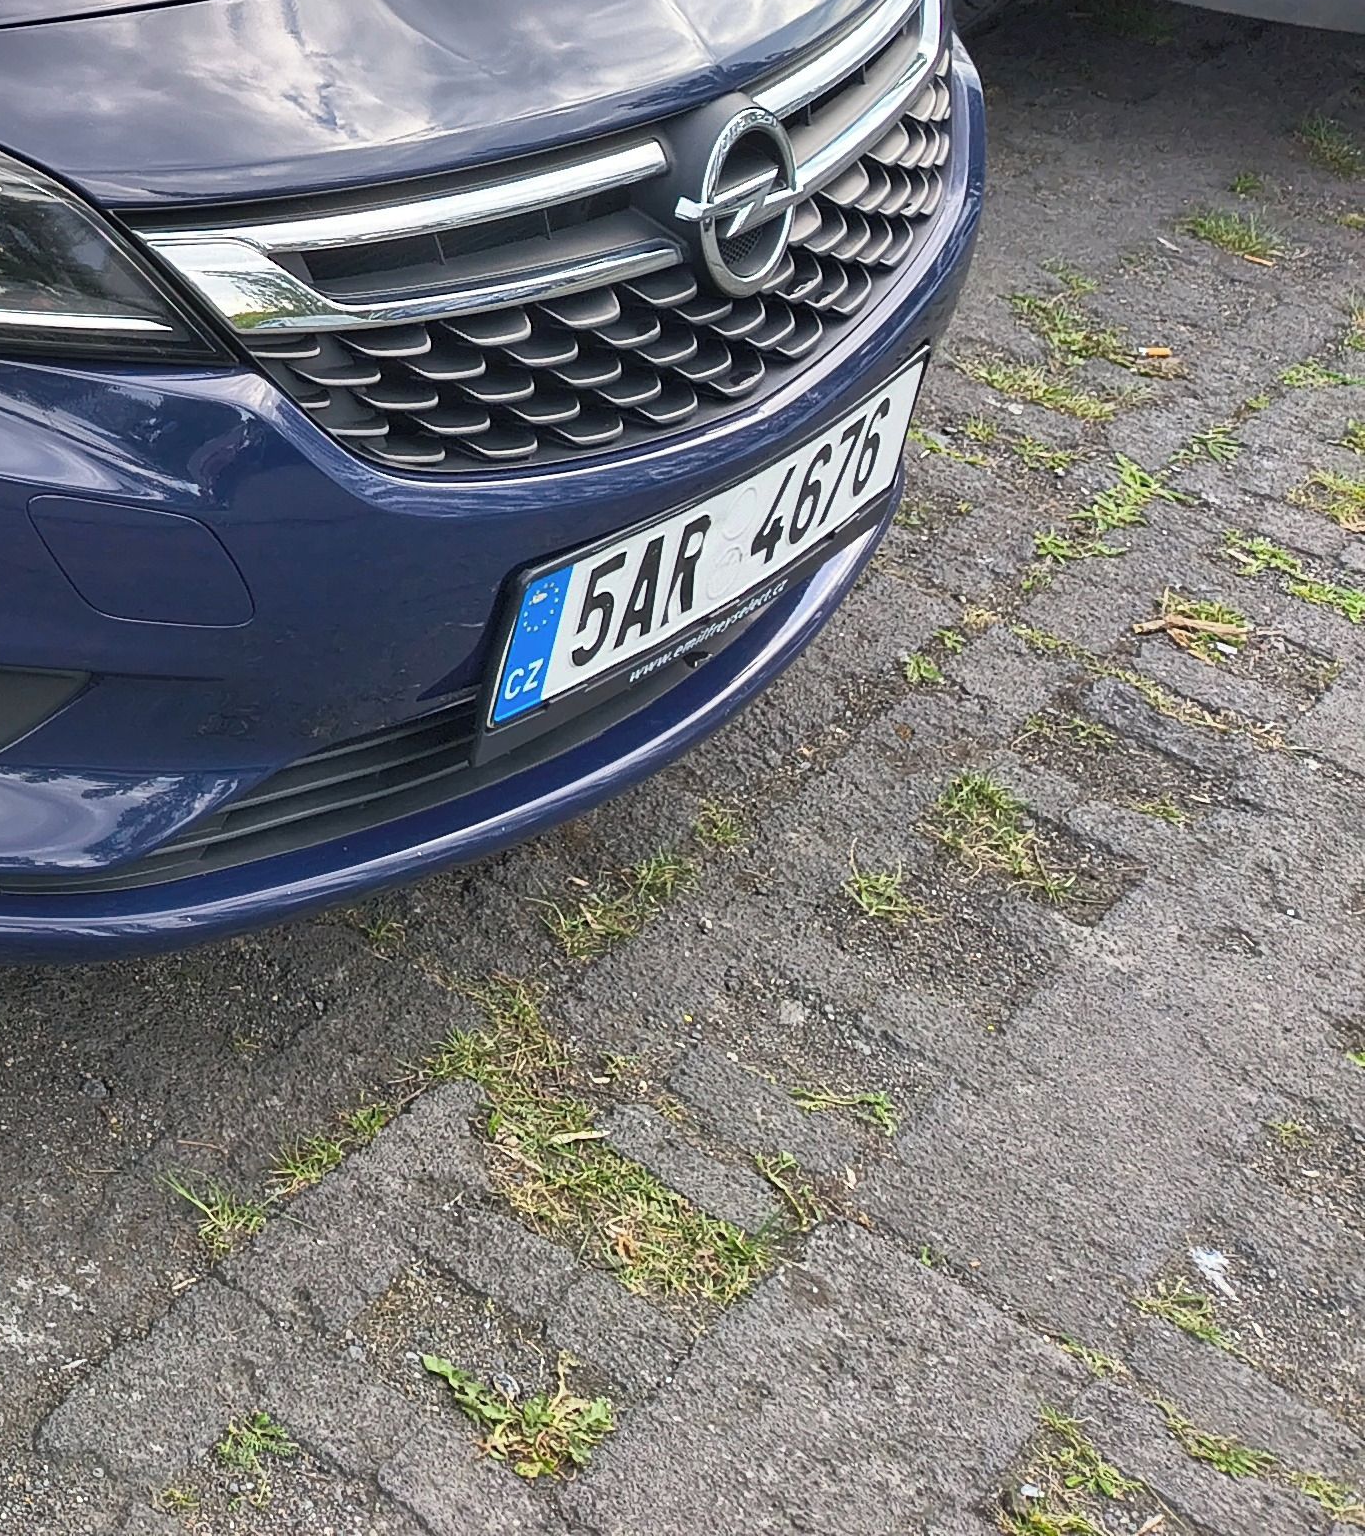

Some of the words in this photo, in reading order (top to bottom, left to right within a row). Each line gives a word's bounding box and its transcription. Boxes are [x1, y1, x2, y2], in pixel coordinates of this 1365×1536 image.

[503, 657, 542, 702] CZ
[571, 514, 712, 668] 5AR
[751, 397, 892, 565] 4676
[629, 579, 788, 683] www.emilfreyselect.cz
